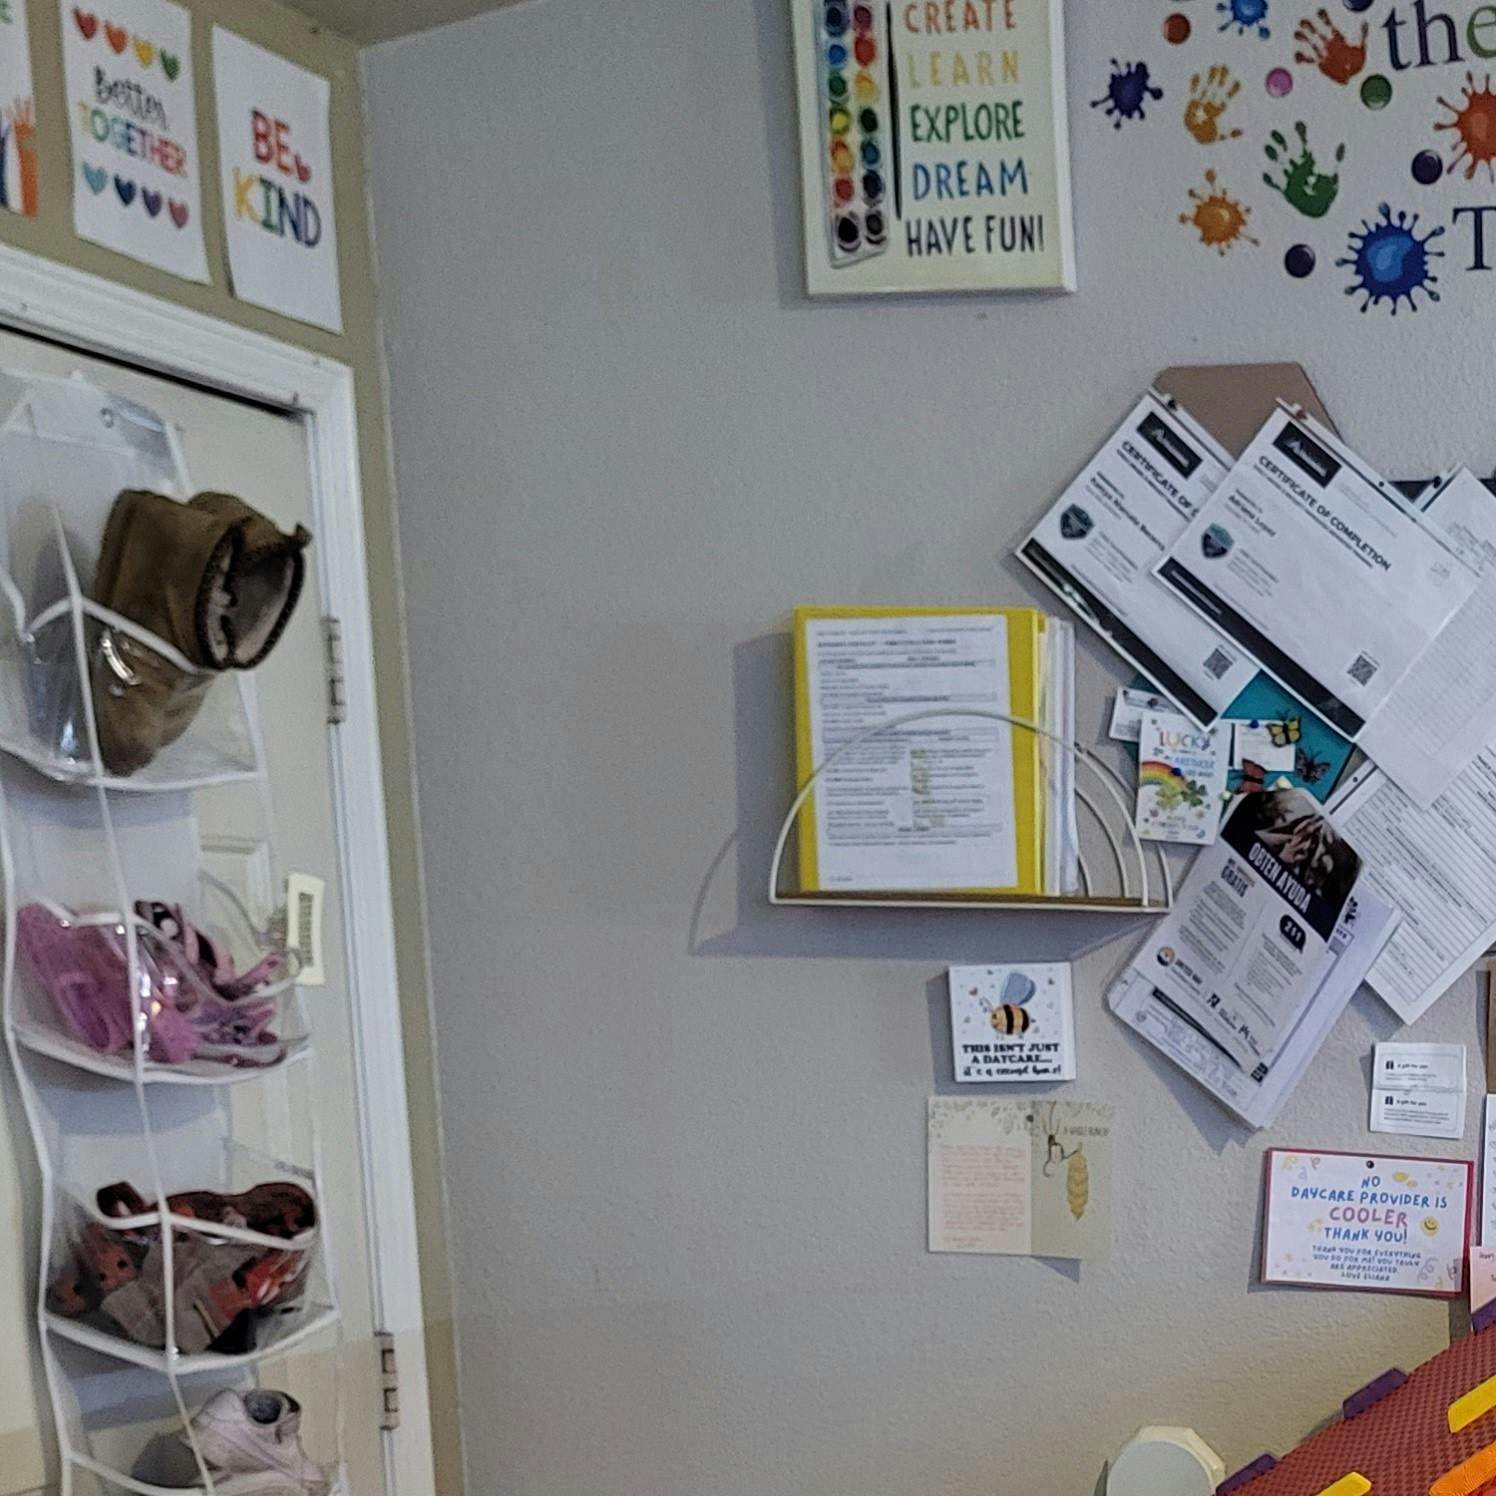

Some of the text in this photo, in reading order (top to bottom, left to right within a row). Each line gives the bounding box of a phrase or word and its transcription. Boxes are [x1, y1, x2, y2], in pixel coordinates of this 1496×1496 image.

[904, 0, 1017, 34] CREATE
[908, 50, 1019, 88] LEARN
[78, 101, 188, 178] TOGETHER
[910, 100, 1025, 143] EXPLORE
[251, 107, 292, 176] BE
[912, 157, 1028, 201] DREAM
[233, 167, 322, 249] KIND
[905, 214, 1045, 257] HAVE FUN!
[1119, 439, 1180, 498] CERTIFICATE
[1175, 493, 1194, 512] OF
[1256, 454, 1318, 509] CERTIFICATE
[1315, 504, 1330, 520] OF
[1328, 515, 1392, 572] COMPLETION
[1159, 730, 1211, 751] LUCKY
[1244, 841, 1315, 913] OBTEN AYUDA
[1282, 920, 1303, 943] 211
[962, 1042, 1059, 1053] THIS ISN'T JUST
[971, 1055, 979, 1063] A
[1290, 1185, 1447, 1208] DAYCARE PROVIDER IS
[1361, 1175, 1380, 1189] NO
[1323, 1226, 1407, 1244] THANK YOU!
[1328, 1205, 1408, 1228] COOLER
